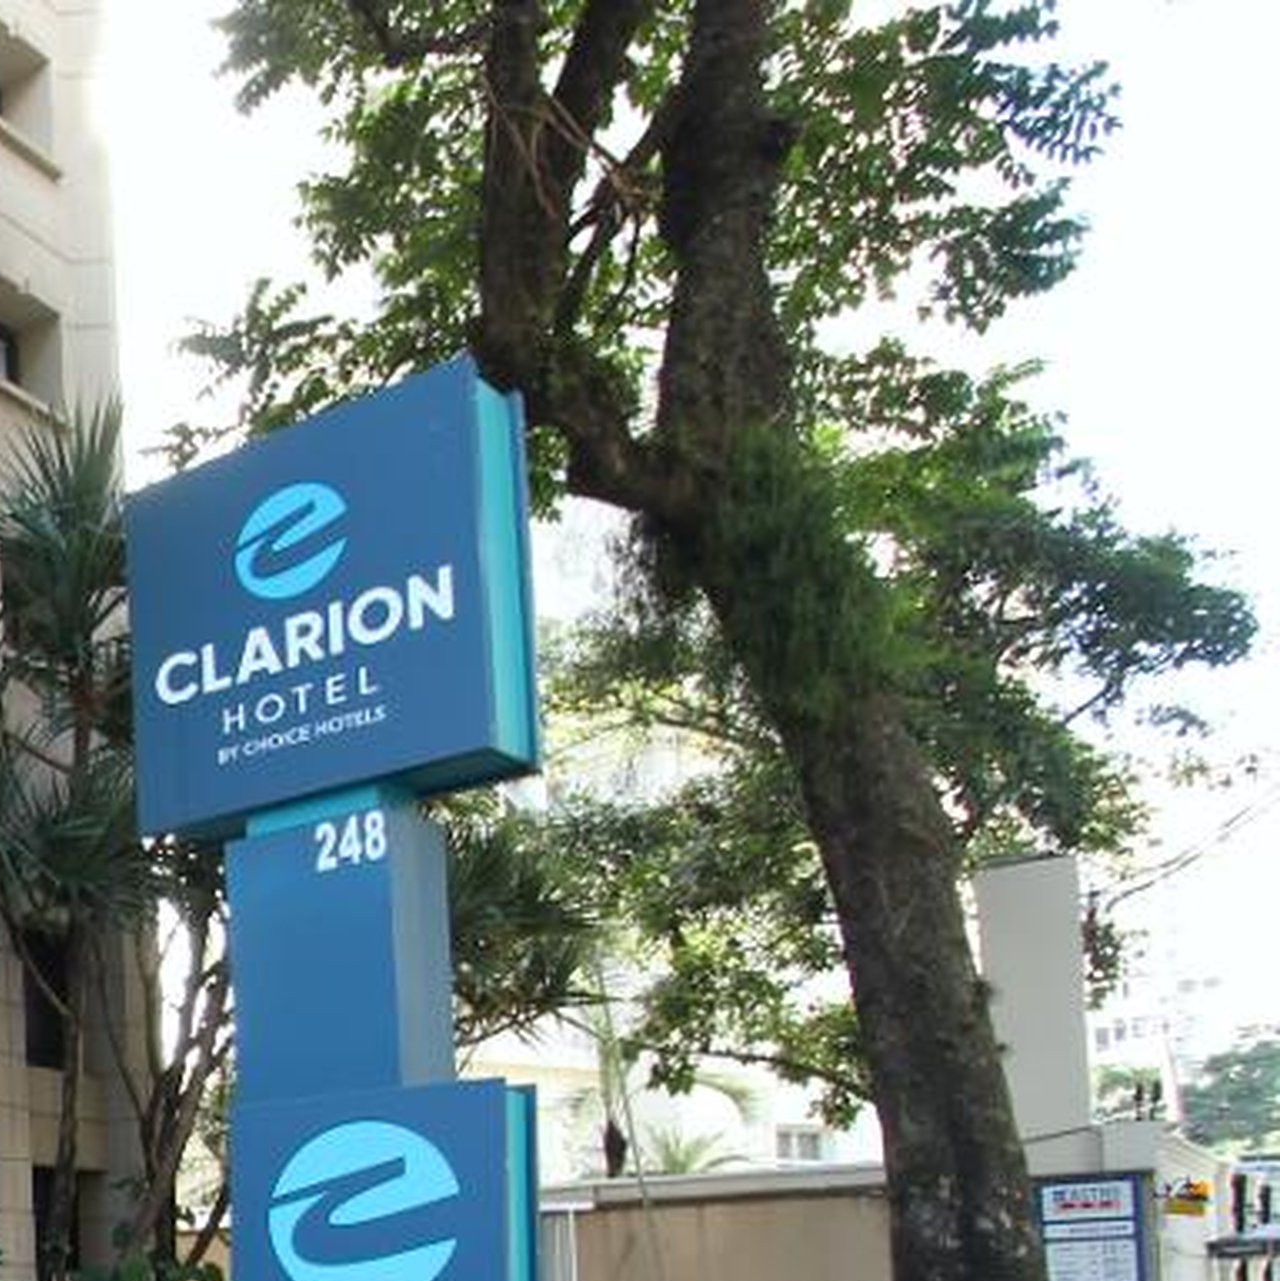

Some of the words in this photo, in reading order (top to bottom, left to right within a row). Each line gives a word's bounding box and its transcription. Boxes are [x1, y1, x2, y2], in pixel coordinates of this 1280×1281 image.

[154, 566, 455, 705] CLARION
[223, 666, 379, 735] HOTEL
[217, 744, 239, 766] BY
[241, 724, 311, 756] CHOICE
[314, 704, 387, 737] HOTELS
[315, 810, 388, 871] 248
